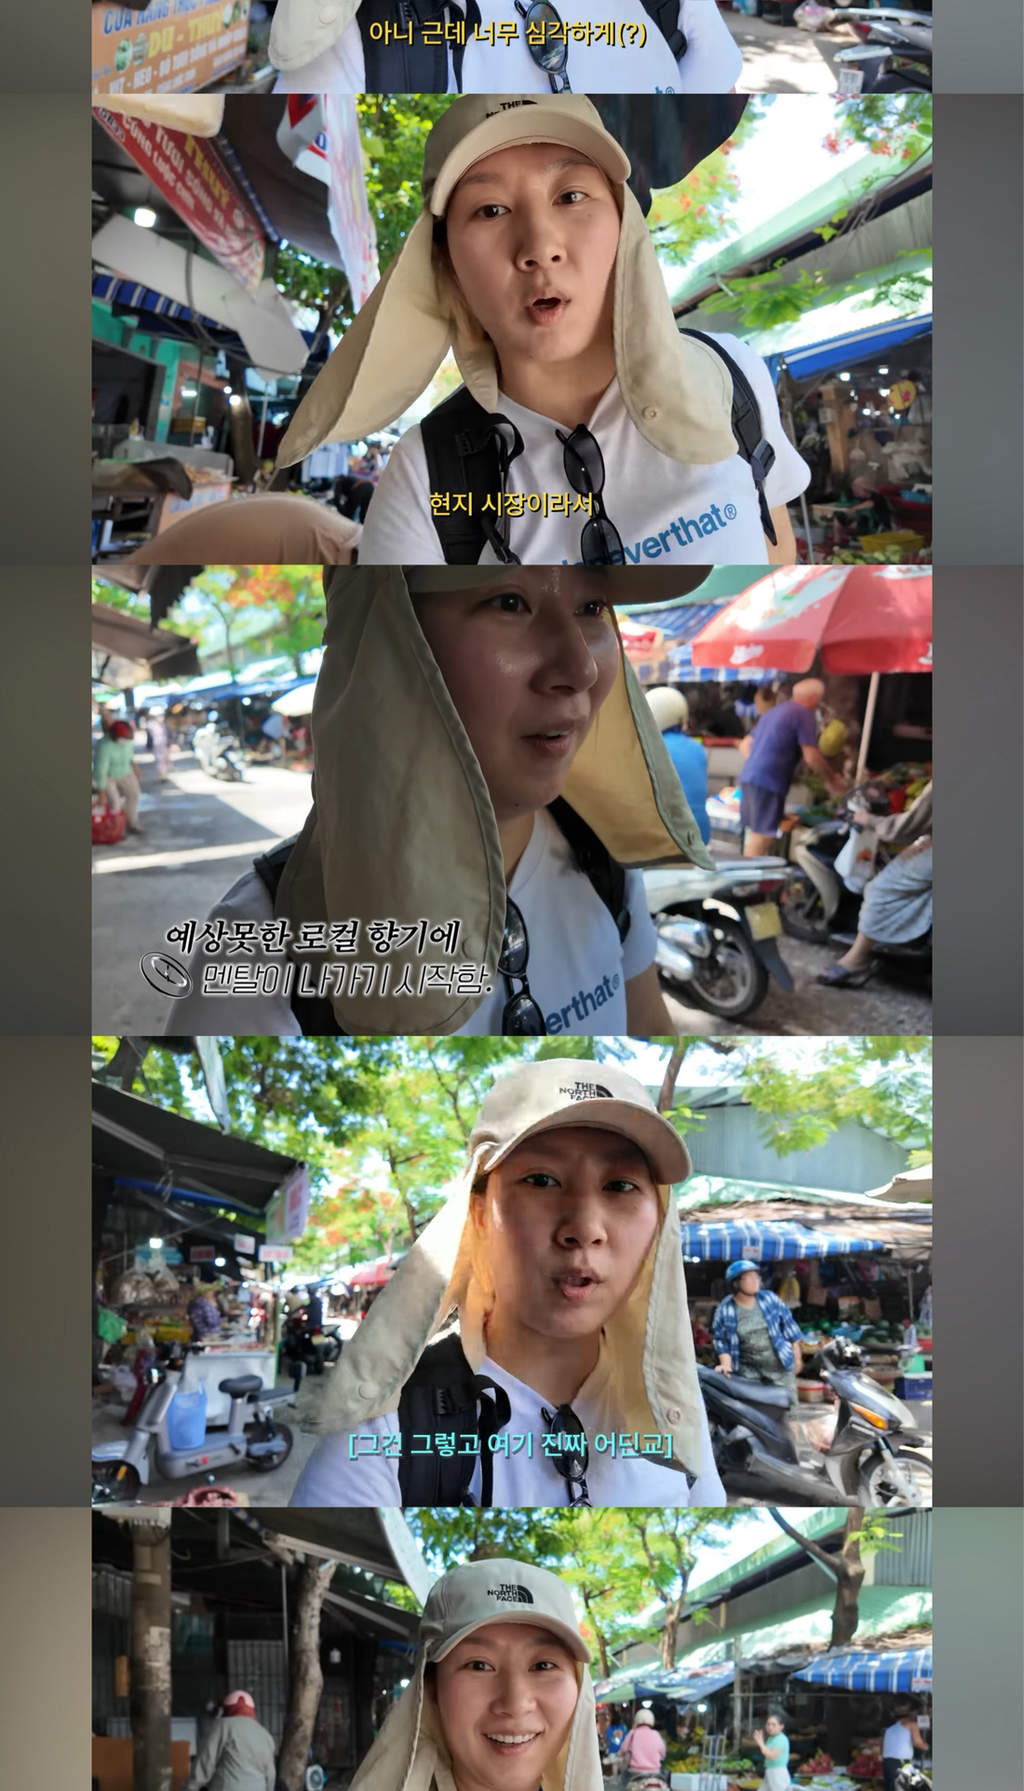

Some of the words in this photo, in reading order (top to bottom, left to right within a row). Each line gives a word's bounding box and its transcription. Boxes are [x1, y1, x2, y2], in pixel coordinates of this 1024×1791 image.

[500, 101, 521, 111] THE
[574, 1081, 595, 1090] THE
[559, 1087, 596, 1097] NORTH
[487, 1589, 518, 1597] NORTH
[496, 1595, 519, 1603] FACE
